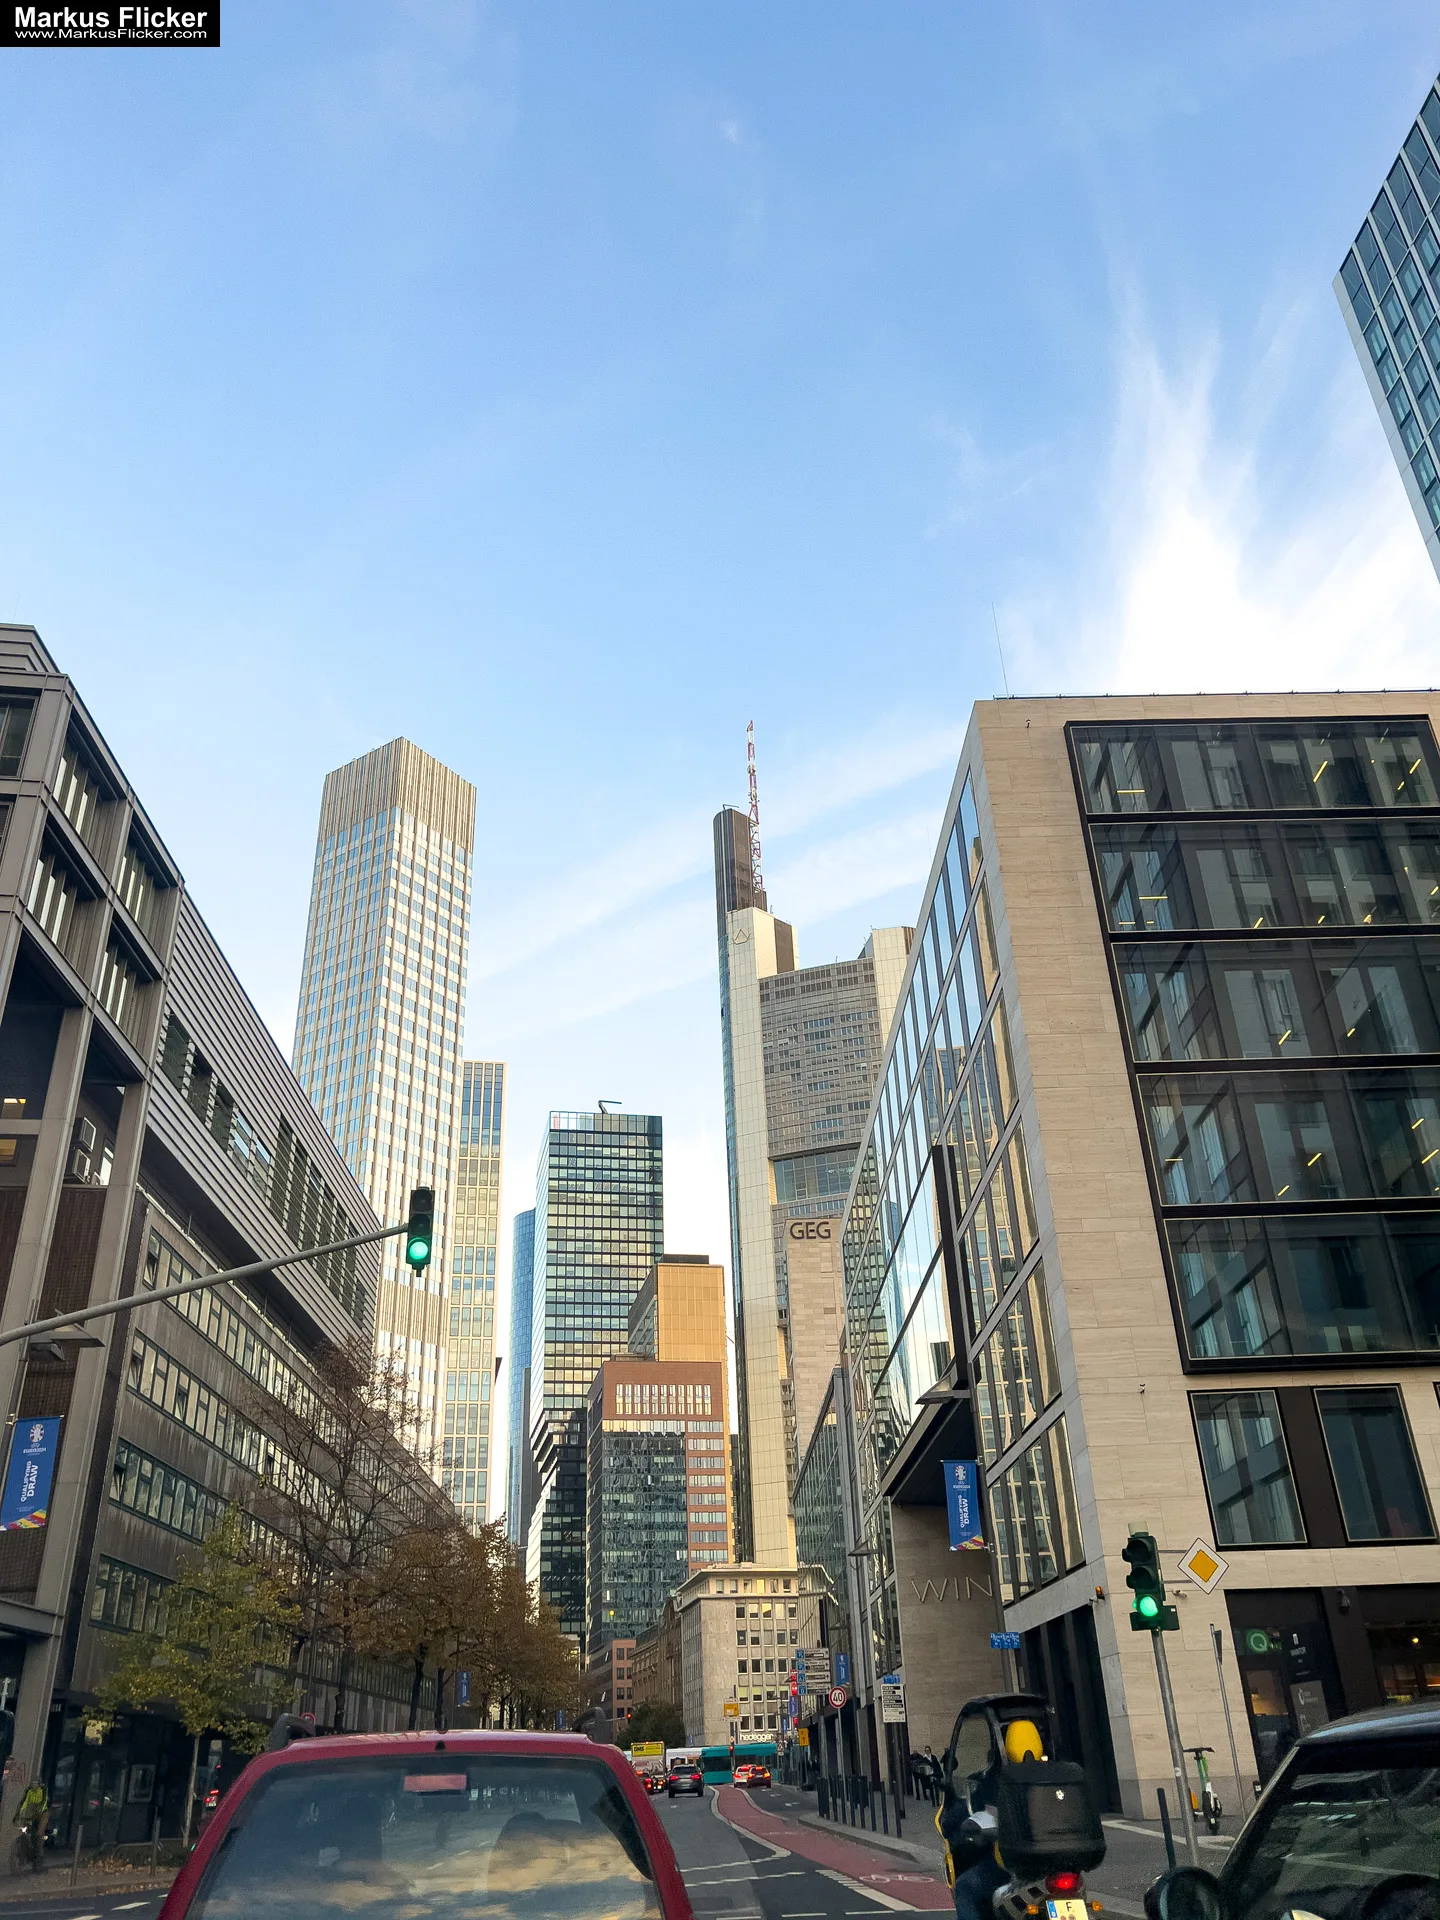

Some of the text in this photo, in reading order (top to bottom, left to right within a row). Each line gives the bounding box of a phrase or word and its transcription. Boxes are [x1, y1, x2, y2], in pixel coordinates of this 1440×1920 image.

[790, 1221, 831, 1240] GEG
[20, 1460, 32, 1502] QUALIFYING
[26, 1464, 39, 1497] DRAW
[833, 1691, 843, 1702] 40
